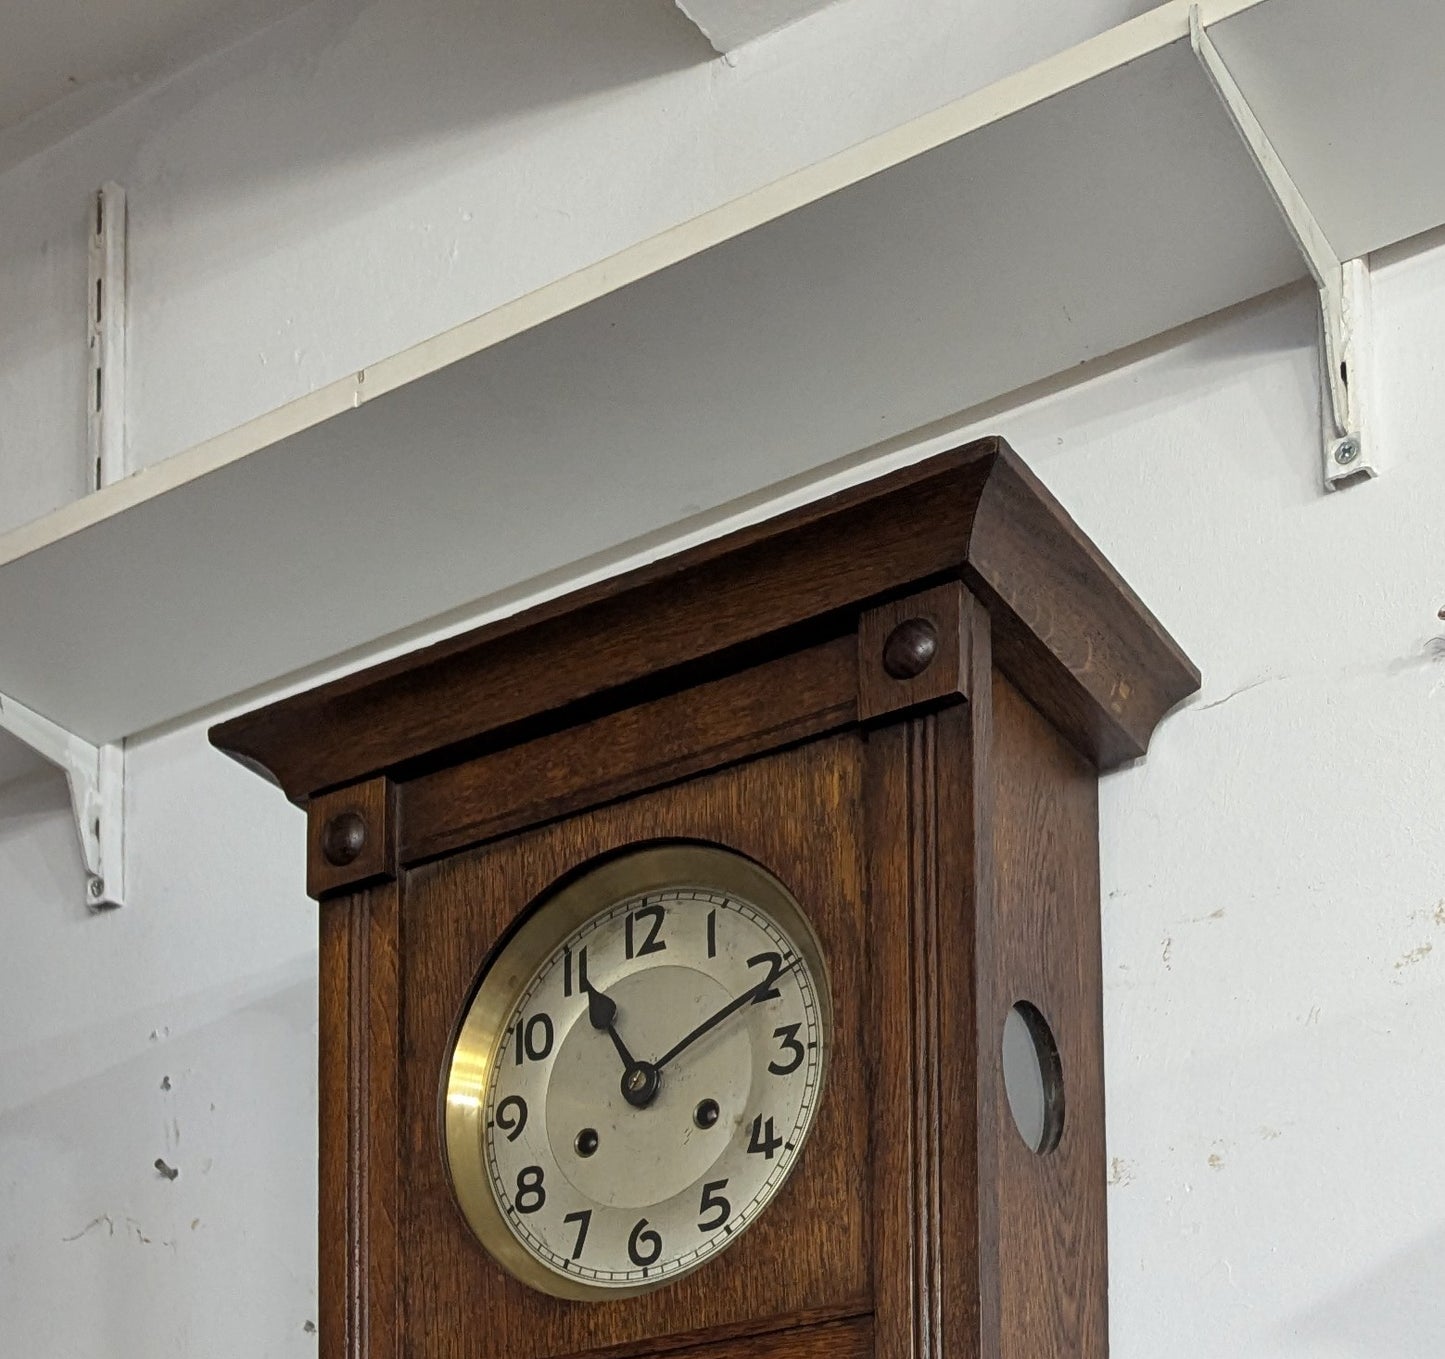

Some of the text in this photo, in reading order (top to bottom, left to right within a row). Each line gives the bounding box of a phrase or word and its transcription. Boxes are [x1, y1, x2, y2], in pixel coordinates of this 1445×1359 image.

[625, 905, 667, 960] 12
[707, 908, 717, 959] 1
[564, 946, 589, 997] 11
[746, 951, 782, 1005] 2
[515, 1012, 554, 1065] 10
[767, 1022, 805, 1076] 3
[496, 1095, 528, 1142] 9
[746, 1113, 783, 1160] 4
[515, 1166, 546, 1214] 8
[697, 1178, 731, 1232] 5
[563, 1209, 593, 1260] 7
[627, 1218, 663, 1267] 6
